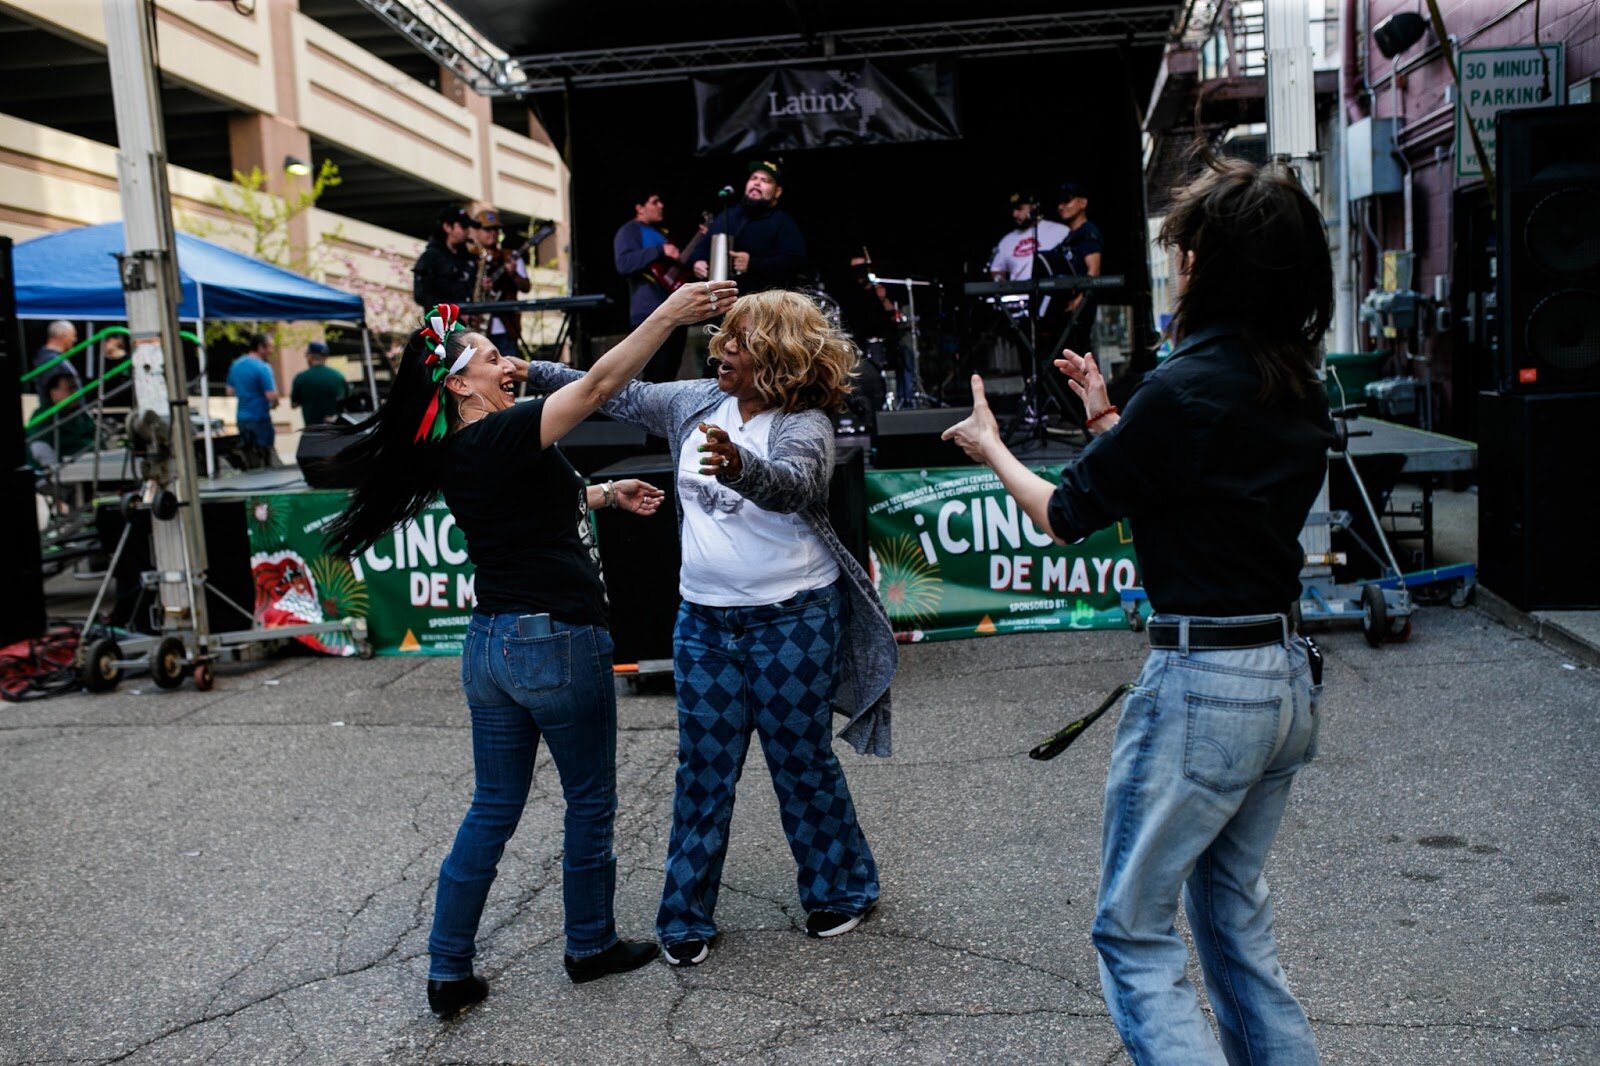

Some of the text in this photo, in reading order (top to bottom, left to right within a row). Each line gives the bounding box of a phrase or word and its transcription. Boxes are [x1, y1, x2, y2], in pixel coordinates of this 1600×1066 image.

[1466, 62, 1486, 80] 30
[768, 88, 855, 117] Latinx
[934, 477, 969, 491] COMMUNITY
[969, 473, 993, 484] CENTER
[914, 494, 1085, 566] ¡CINC
[989, 554, 1136, 594] DE MAYO
[410, 571, 449, 608] DE
[1009, 600, 1054, 613] SPONSORED
